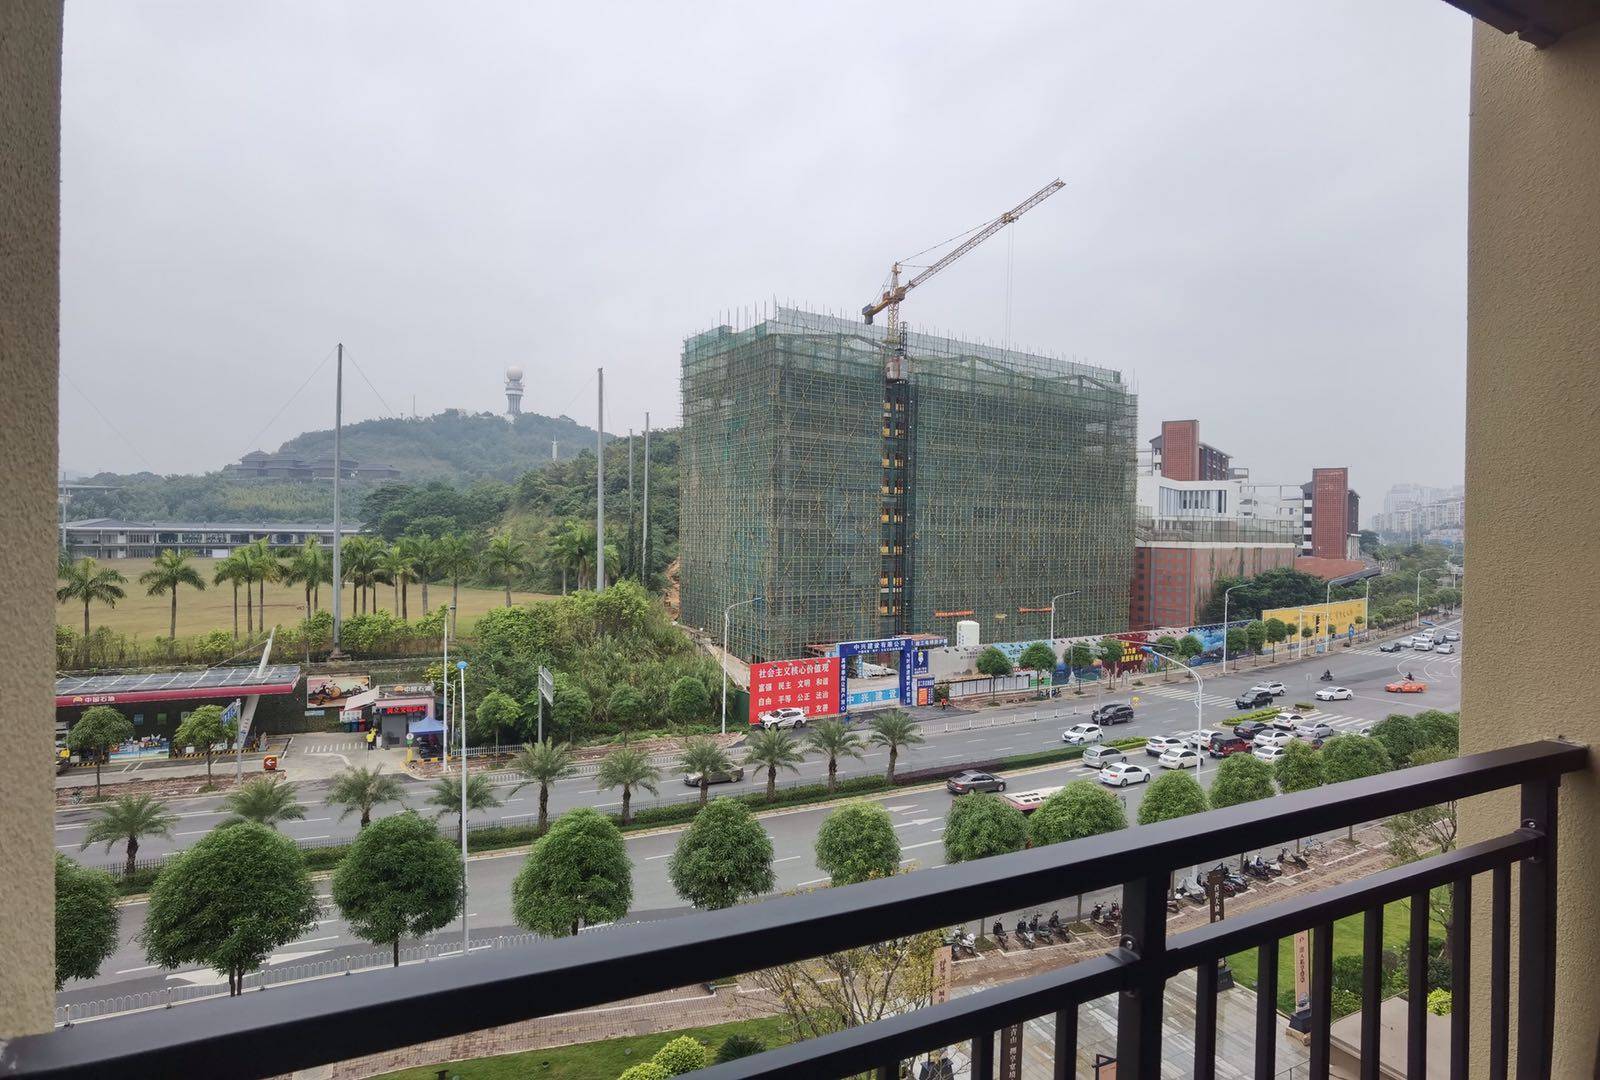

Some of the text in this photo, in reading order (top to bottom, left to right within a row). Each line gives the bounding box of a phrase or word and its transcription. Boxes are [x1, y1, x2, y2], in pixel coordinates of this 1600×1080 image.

[758, 662, 830, 678] 社会主义核心价值观
[758, 677, 829, 693] 富强 民主 文明 和谐
[758, 691, 829, 707] 自由 平等 公正 法治
